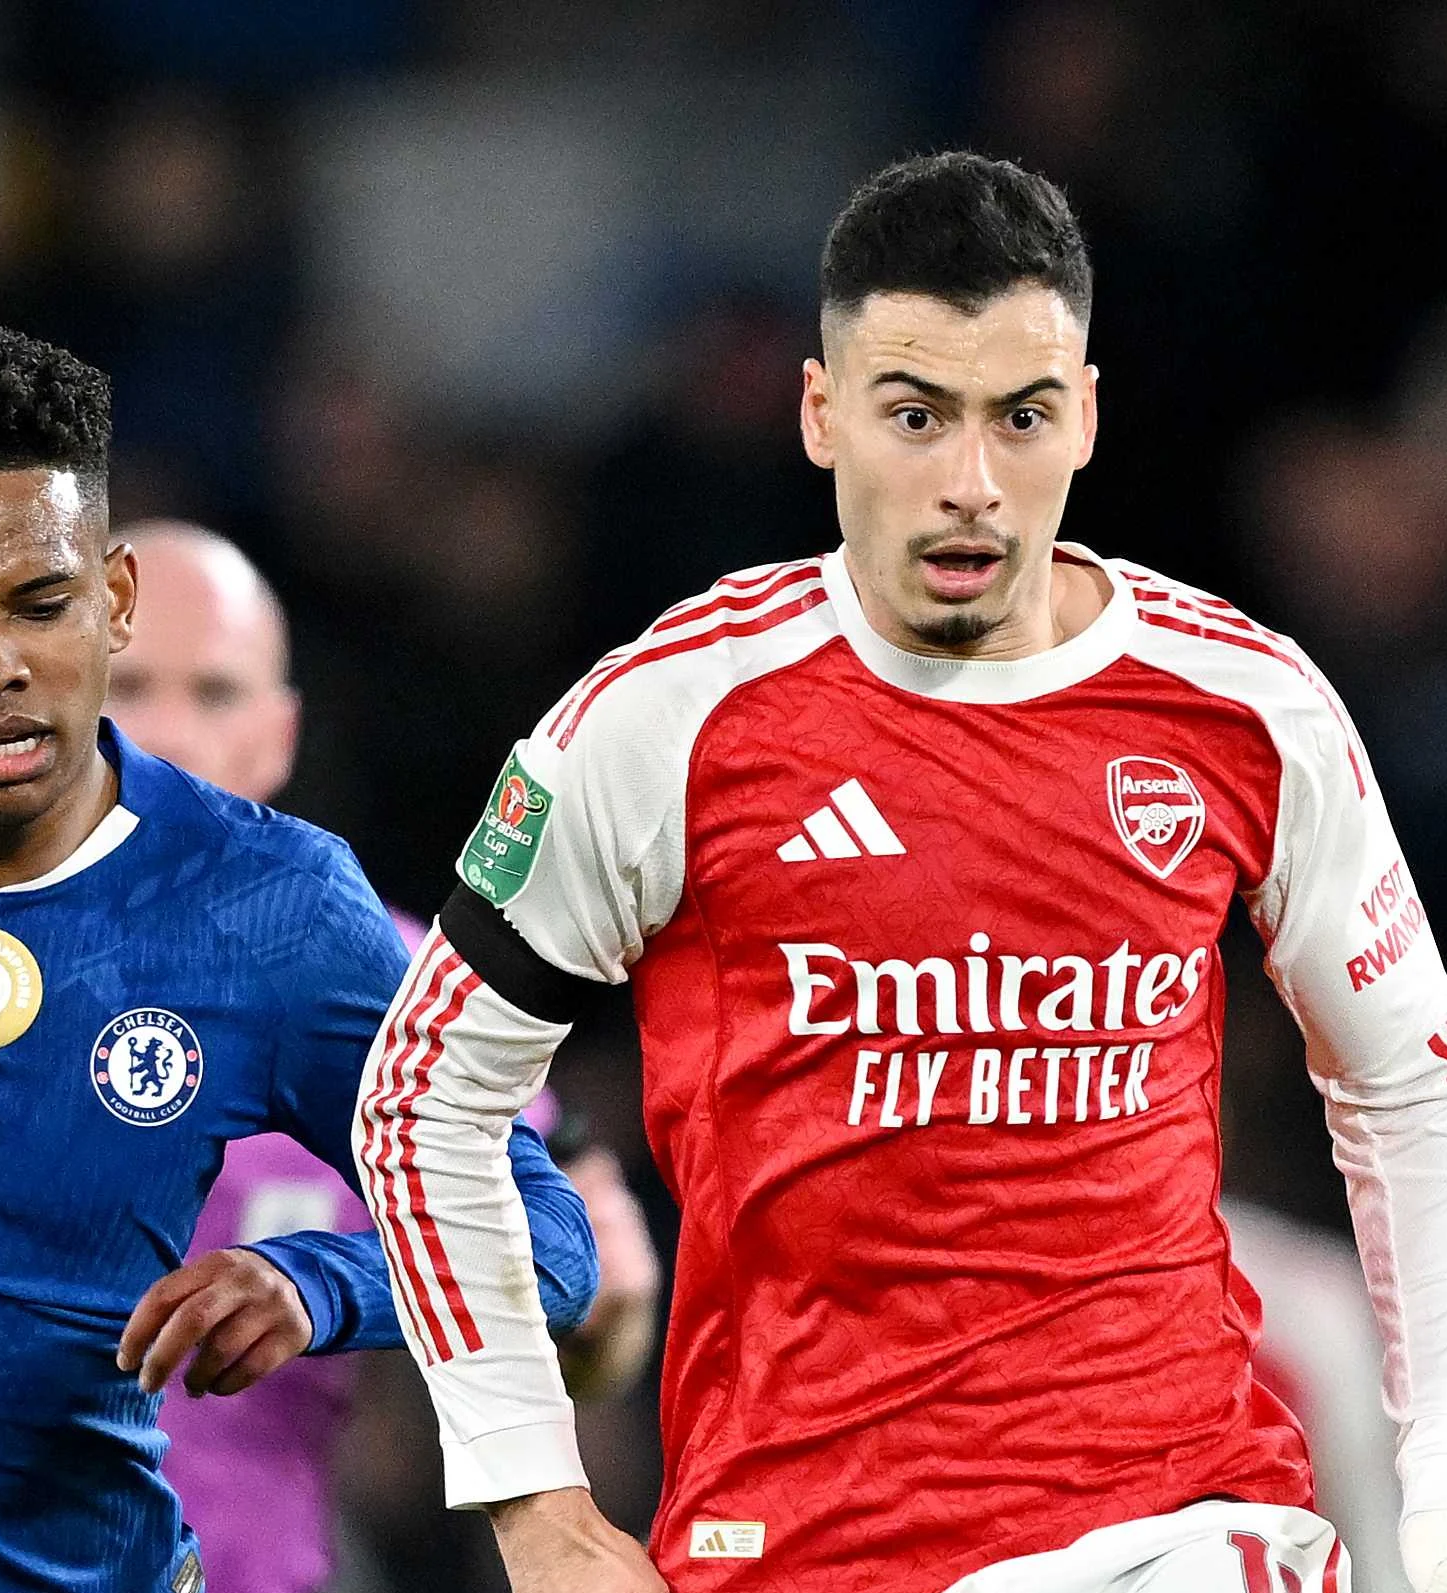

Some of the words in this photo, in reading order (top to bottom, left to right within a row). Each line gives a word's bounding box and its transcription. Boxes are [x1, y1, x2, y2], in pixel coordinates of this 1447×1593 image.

[483, 829, 508, 857] Cup
[483, 857, 495, 870] 2
[1360, 860, 1405, 928] VISIT
[778, 931, 1208, 1036] Emirates
[112, 1012, 184, 1039] CHELSEA
[847, 1048, 949, 1128] FLY
[967, 1041, 1154, 1126] BETTER
[110, 1097, 156, 1120] FOOTBALL
[159, 1098, 183, 1117] CLUB
